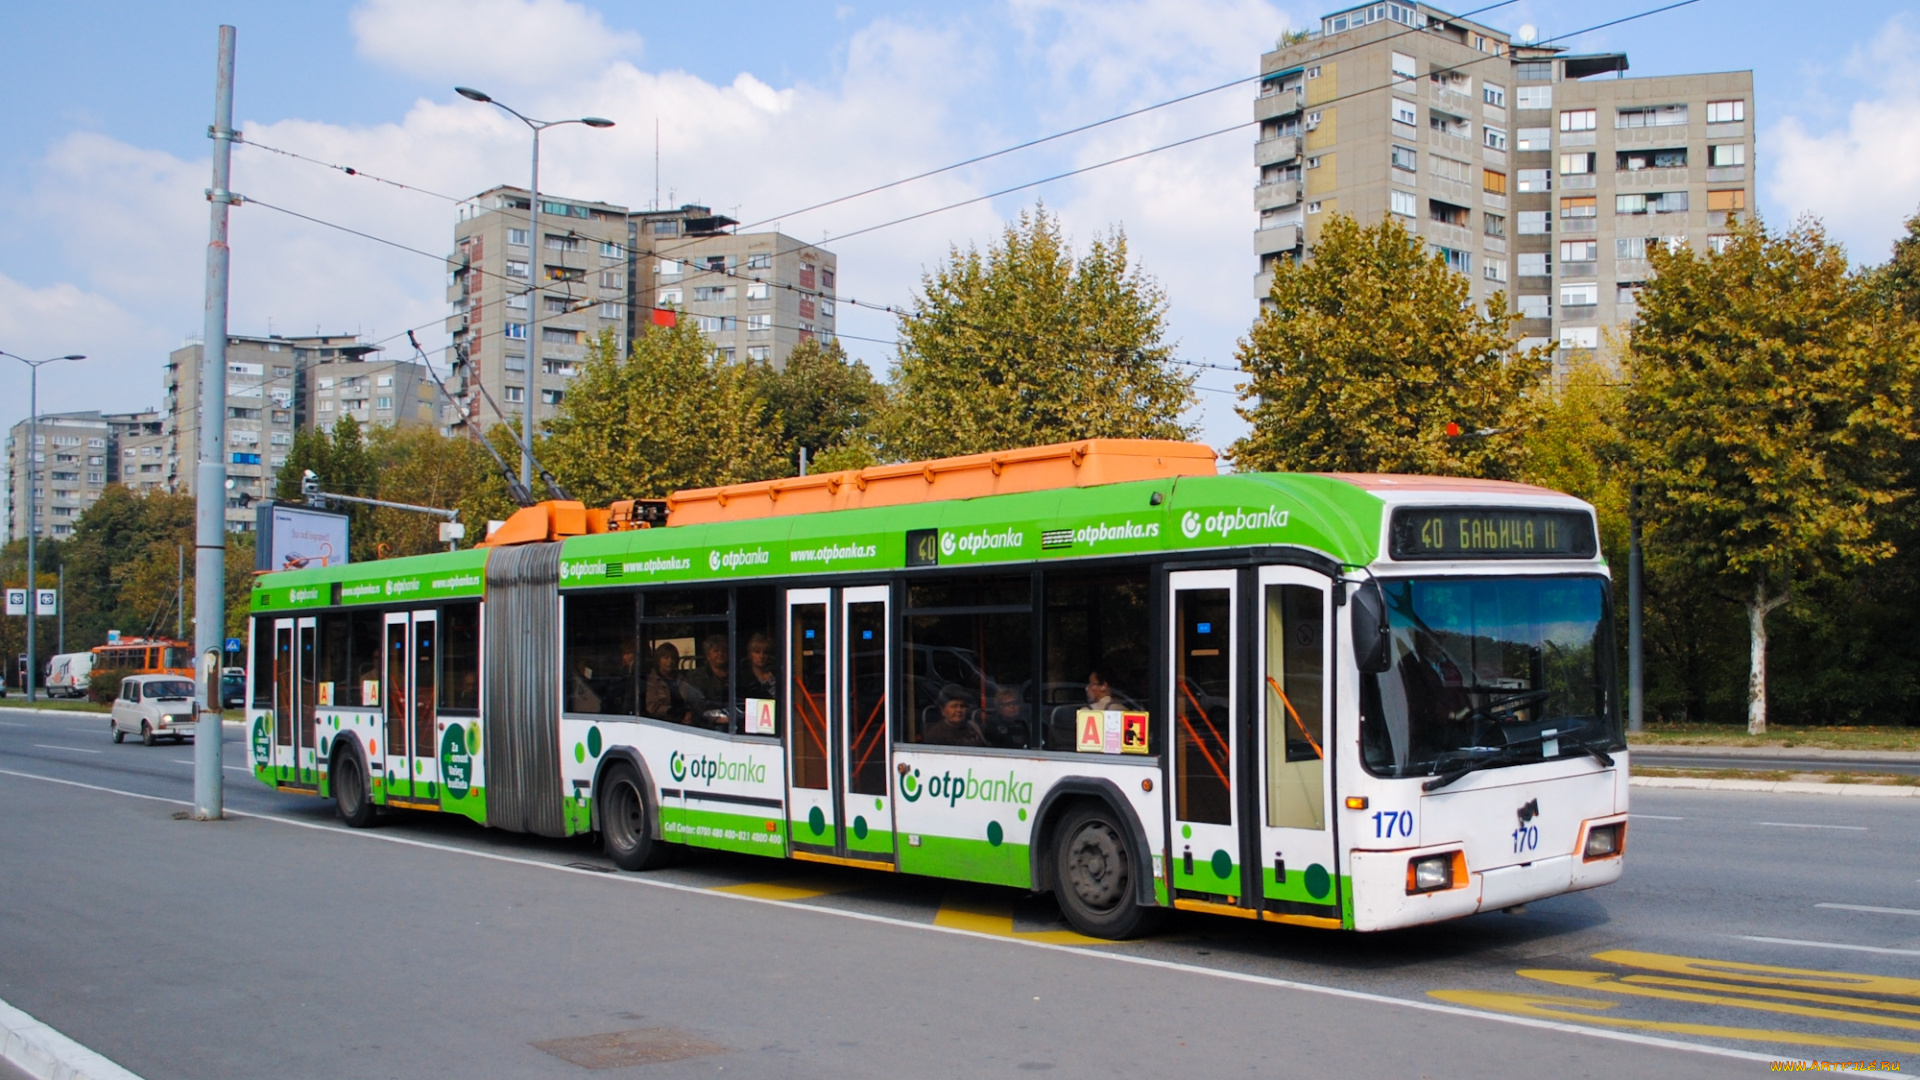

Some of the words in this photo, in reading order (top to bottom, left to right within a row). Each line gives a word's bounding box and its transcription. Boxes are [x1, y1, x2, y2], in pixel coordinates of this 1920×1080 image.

[1205, 504, 1289, 538] otpbanka
[1421, 518, 1443, 548] 40
[1459, 518, 1534, 550] БАЊИЦА
[790, 542, 876, 565] www.otpbanka.rs
[918, 535, 936, 561] 40
[959, 527, 1023, 555] otpbanka
[570, 559, 607, 580] otpbanka
[623, 556, 691, 575] www.otpbanka.rs
[722, 546, 769, 571] otpbanka
[371, 684, 377, 700] A
[760, 704, 772, 727] A
[1082, 716, 1101, 744] A
[691, 752, 766, 787] otpbanka
[928, 768, 1033, 808] otpbanka
[664, 821, 676, 832] Call
[1372, 810, 1413, 838] 170
[1511, 825, 1539, 854] 170
